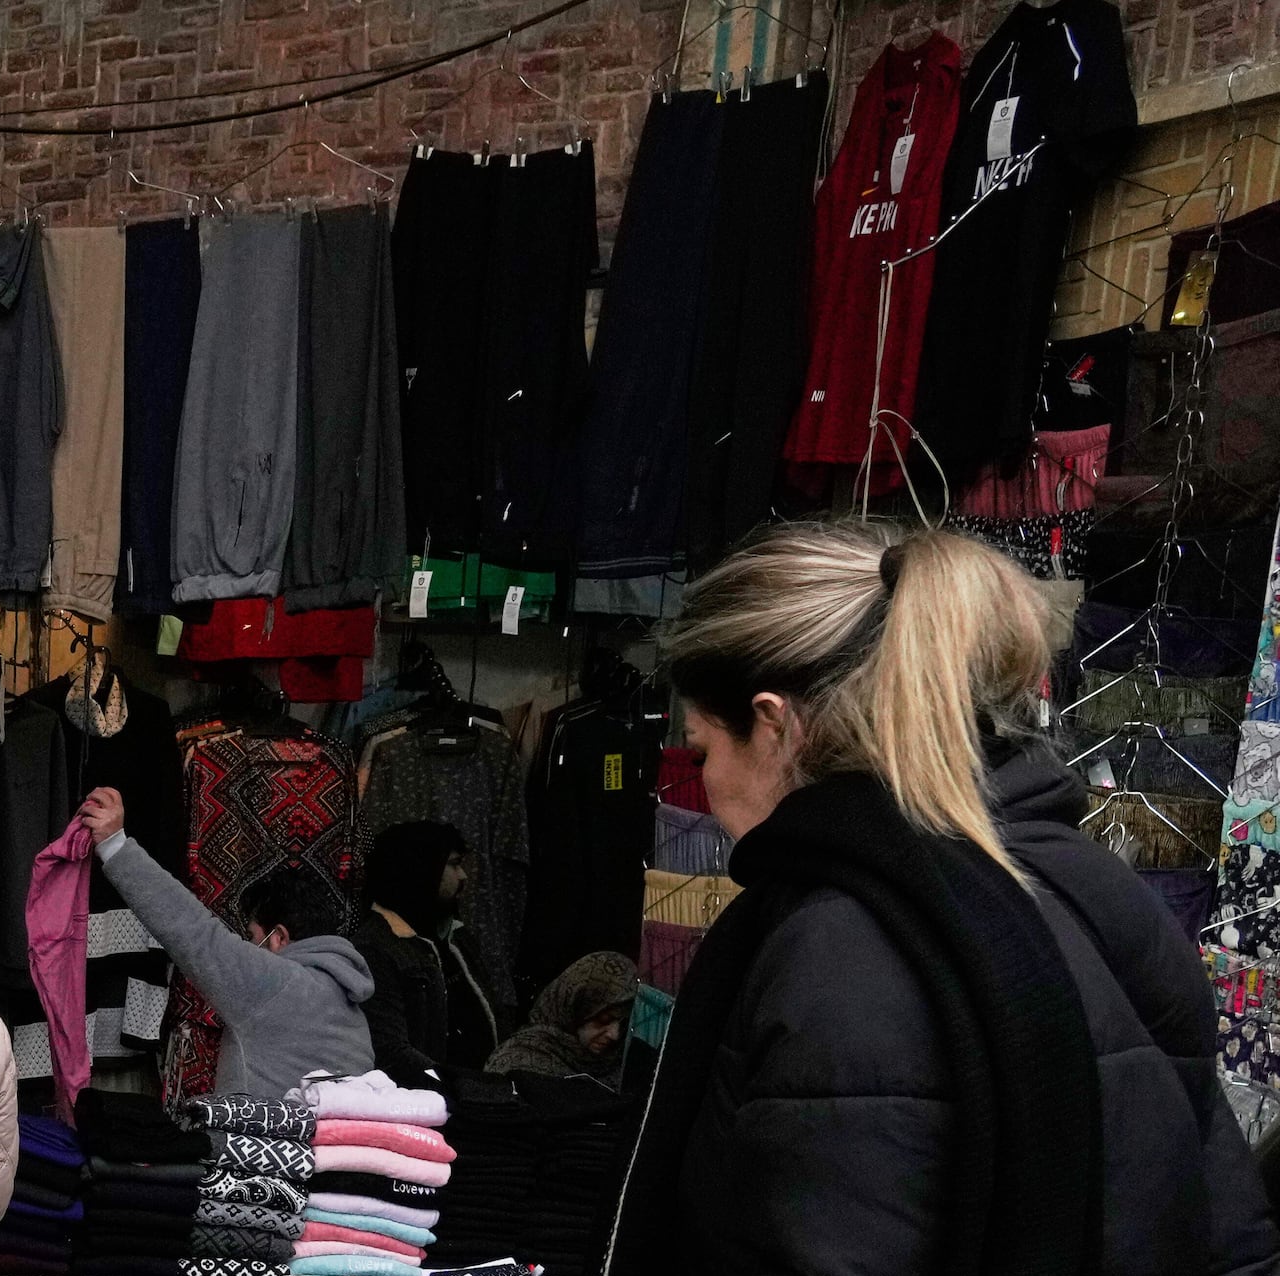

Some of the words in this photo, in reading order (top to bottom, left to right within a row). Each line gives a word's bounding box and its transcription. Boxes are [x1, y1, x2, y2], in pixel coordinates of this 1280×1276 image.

[848, 204, 877, 238] KE
[397, 1127, 422, 1139] Love
[393, 1180, 418, 1195] Love
